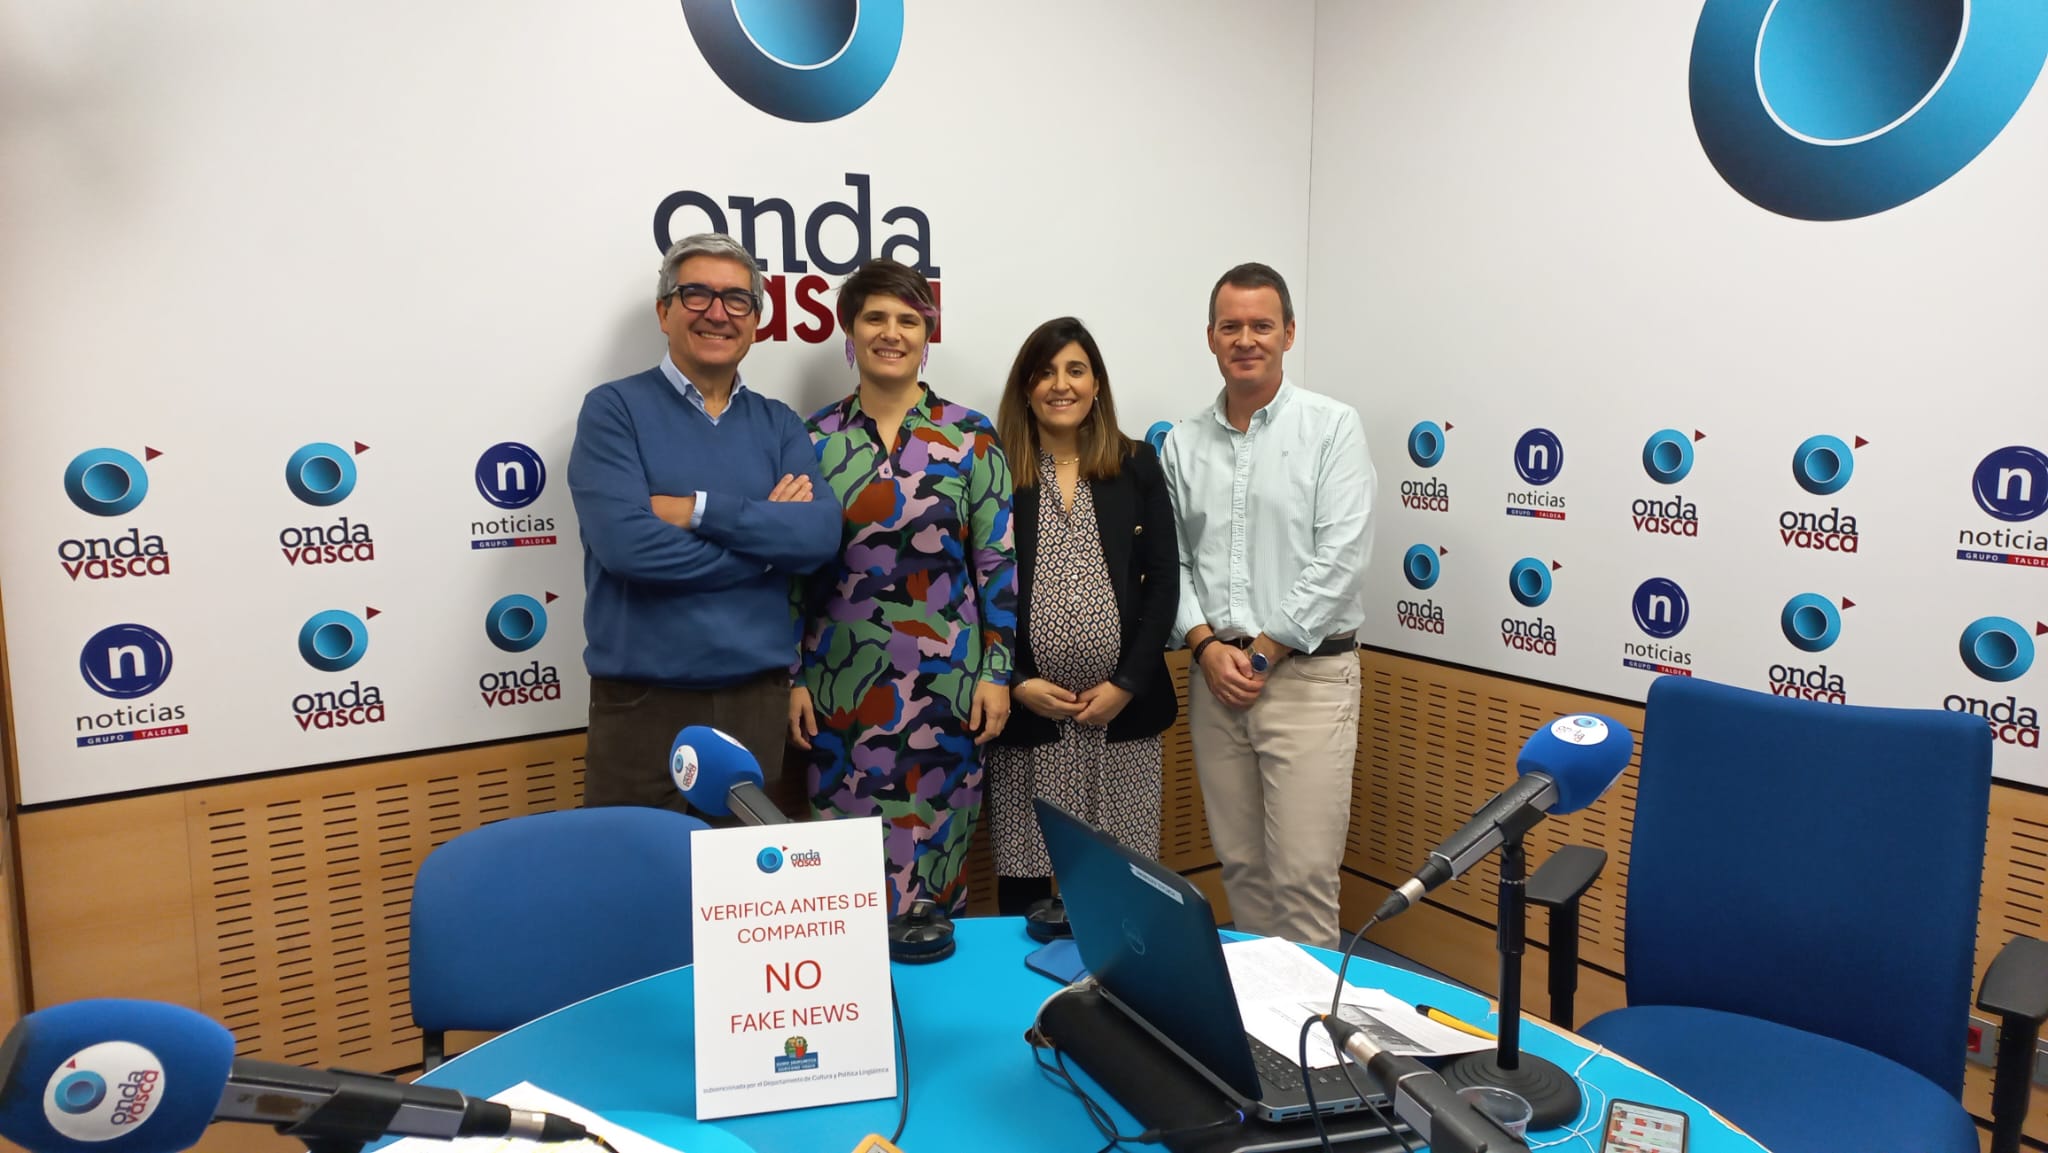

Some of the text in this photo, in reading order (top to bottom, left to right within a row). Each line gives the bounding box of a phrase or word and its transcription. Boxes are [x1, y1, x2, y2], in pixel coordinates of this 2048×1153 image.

[653, 172, 941, 279] onda
[1401, 477, 1448, 498] onda
[1507, 490, 1566, 508] noticias
[1401, 495, 1449, 512] vasca
[1539, 511, 1562, 519] TALDEA
[1632, 496, 1698, 521] onda
[280, 517, 374, 546] onda
[471, 514, 556, 535] noticias
[1633, 515, 1698, 537] vasca
[1779, 507, 1859, 536] onda
[58, 528, 169, 560] onda
[479, 537, 552, 548] GRUPO TALDEA
[1780, 529, 1859, 553] vasca
[282, 541, 375, 567] vasca
[1965, 552, 2048, 567] GRUPO TALDE
[61, 554, 171, 581] vasca
[1397, 599, 1445, 621] onda
[1397, 614, 1445, 635] vasca
[1501, 618, 1555, 641] onda
[1502, 634, 1556, 656] vasca
[1624, 642, 1692, 665] noticias
[479, 661, 560, 691] onda
[1629, 660, 1687, 676] GRUPO TALDEA
[1769, 664, 1846, 694] onda
[293, 681, 384, 712] onda
[481, 681, 561, 708] vasca
[76, 702, 186, 731] noticias
[294, 703, 385, 732] vasca
[1943, 694, 2040, 729] onda
[87, 727, 181, 745] GRUPO TALDEA
[1989, 721, 2040, 749] sca
[790, 849, 820, 861] onda
[792, 857, 821, 868] vasca
[700, 892, 878, 921] VERIFICA ANTES DE
[737, 920, 846, 944] COMPARTIR
[765, 960, 822, 993] NO
[731, 1003, 859, 1033] FAKE NEWS
[111, 1070, 145, 1126] onda
[124, 1069, 160, 1125] vasca
